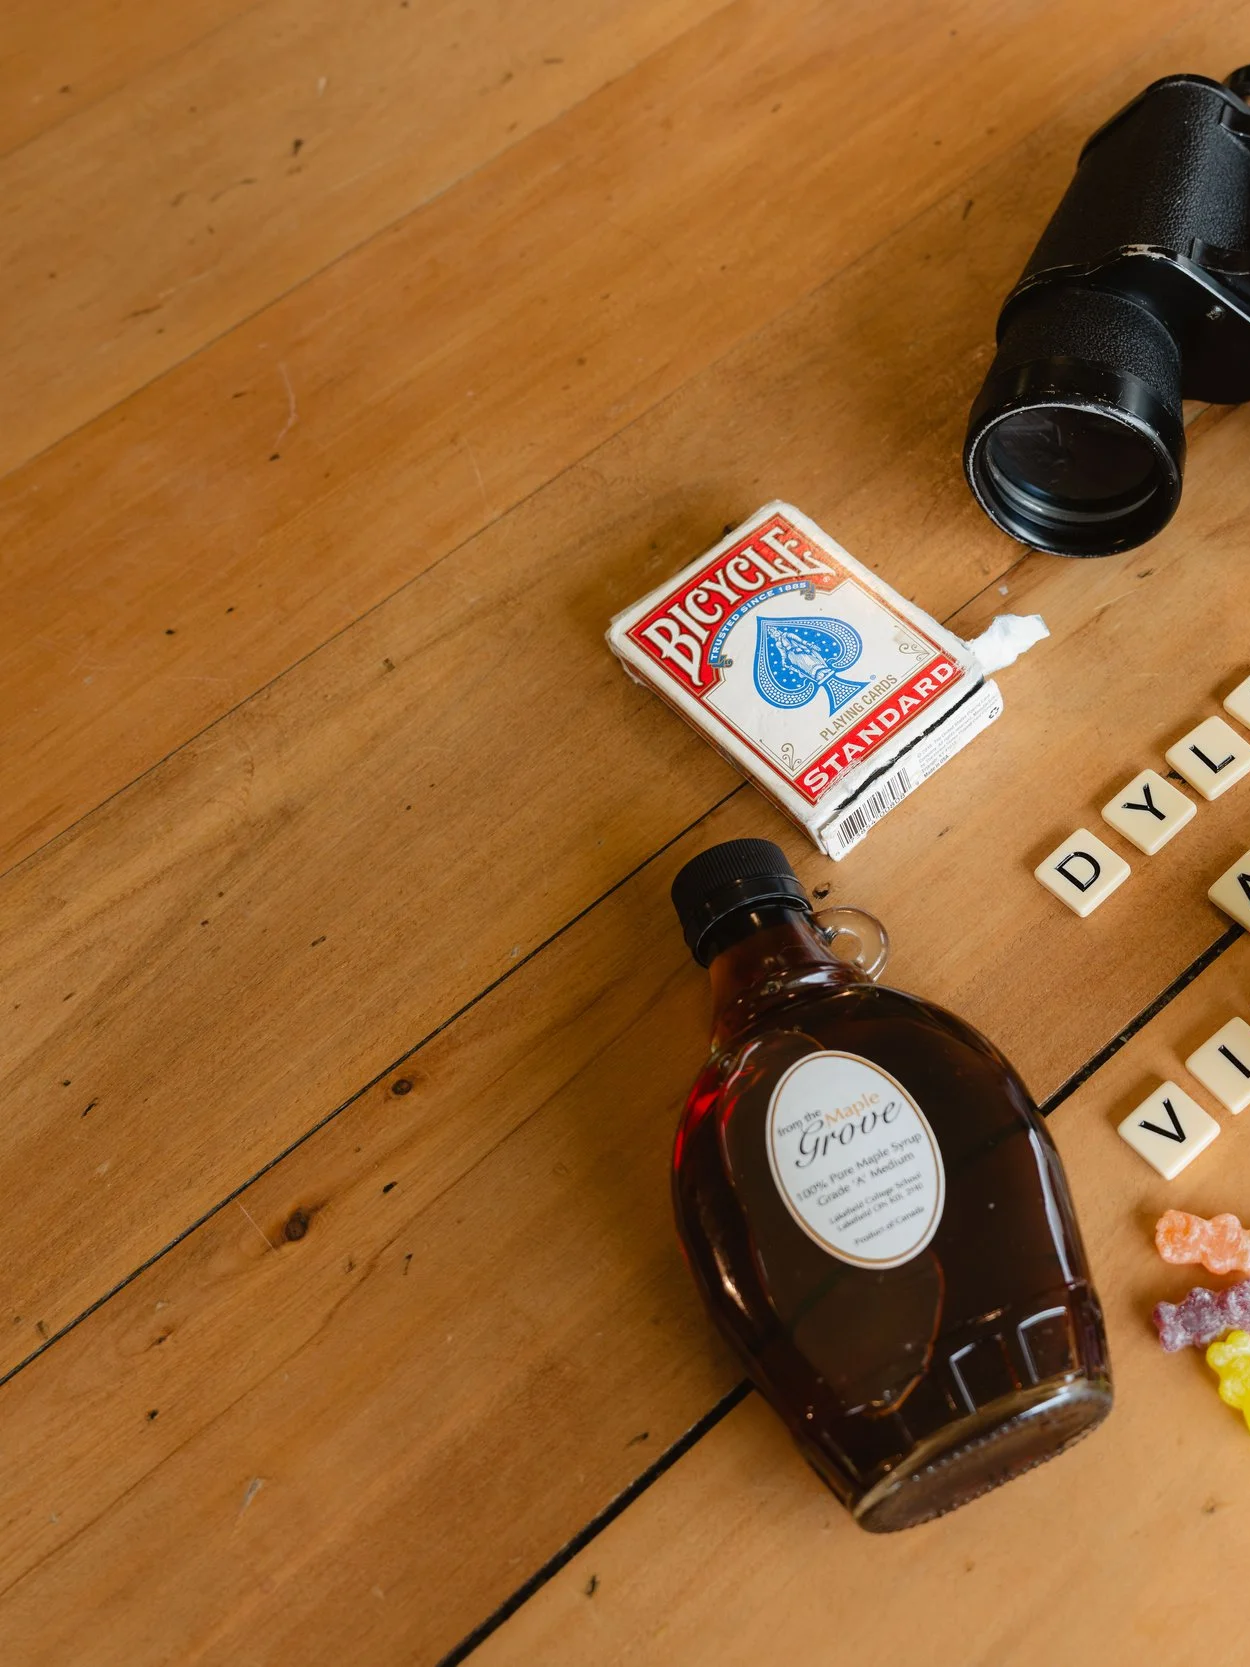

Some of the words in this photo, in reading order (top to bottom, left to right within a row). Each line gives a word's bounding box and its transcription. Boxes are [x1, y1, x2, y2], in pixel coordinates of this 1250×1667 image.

[641, 526, 836, 686] BICYCLE
[711, 614, 740, 660] TRUSTED
[740, 590, 775, 613] SINCE
[778, 582, 807, 593] 1885
[803, 663, 955, 793] STANDARD
[819, 702, 864, 741] PLAYING
[861, 674, 898, 705] CARDS
[778, 1120, 803, 1136] from
[804, 1110, 822, 1122] the
[795, 1101, 902, 1168] Grove
[824, 1092, 880, 1128] Maple
[796, 1180, 828, 1202] 100%
[830, 1167, 854, 1183] Pure
[856, 1148, 889, 1169] Maple
[891, 1133, 922, 1152] Syrup
[818, 1184, 850, 1206] Grade
[870, 1152, 915, 1178] Medium
[830, 1200, 864, 1224] Lakefield
[864, 1187, 893, 1204] College
[894, 1171, 922, 1188] School
[854, 1226, 884, 1246] Product
[895, 1206, 925, 1223] Canada
